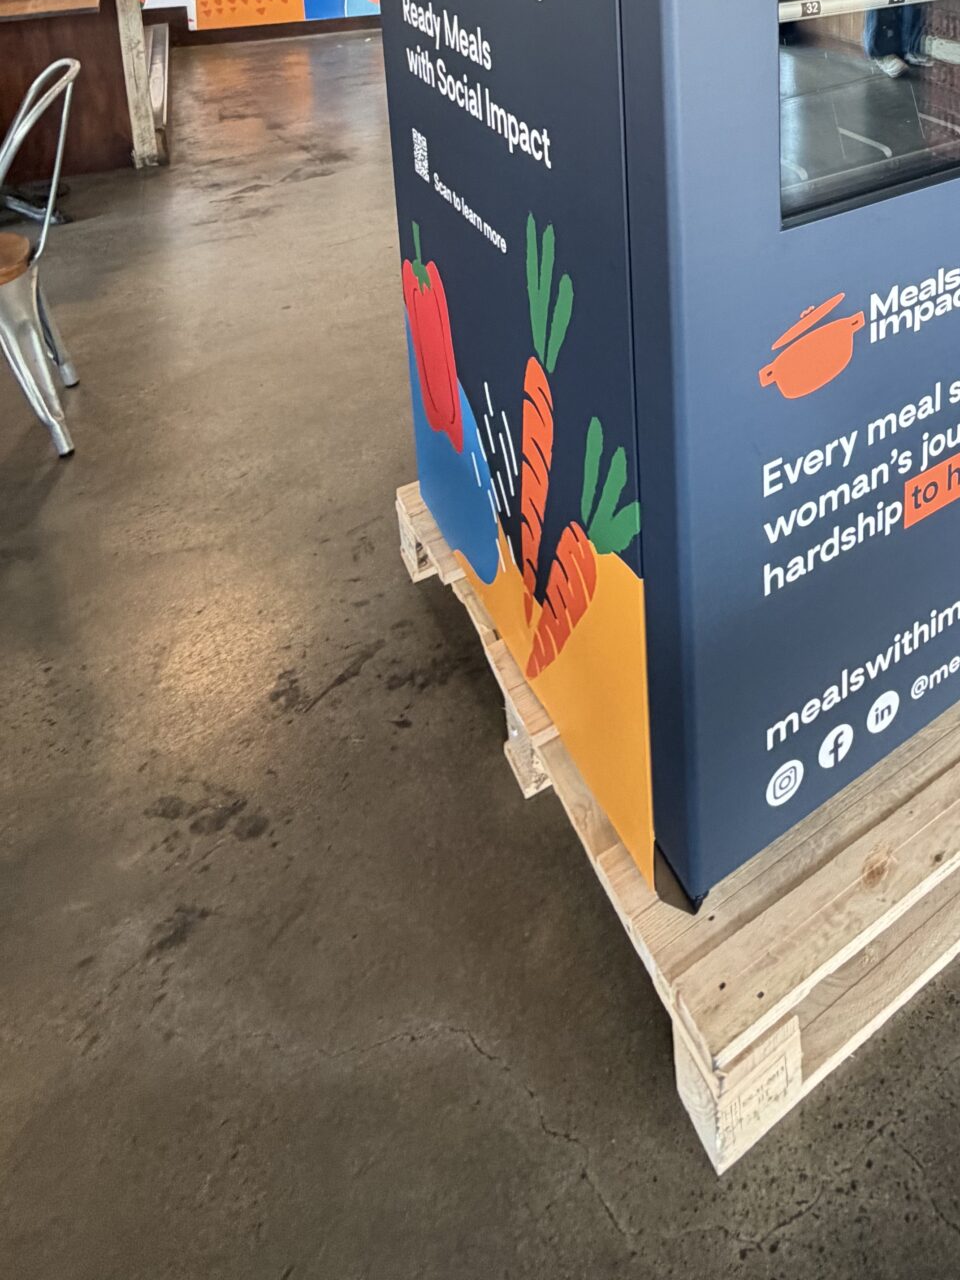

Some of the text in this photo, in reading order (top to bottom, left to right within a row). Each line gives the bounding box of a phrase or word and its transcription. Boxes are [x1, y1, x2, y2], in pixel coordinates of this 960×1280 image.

[443, 9, 492, 70] Meals
[806, 1, 818, 14] 32
[406, 45, 552, 169] with Social Impact
[434, 172, 507, 253] Scan to learn more
[870, 267, 960, 321] Meals
[762, 430, 858, 498] Every
[867, 382, 942, 446] meal
[763, 448, 913, 544] woman's
[763, 499, 903, 597] hardship
[911, 477, 939, 510] to
